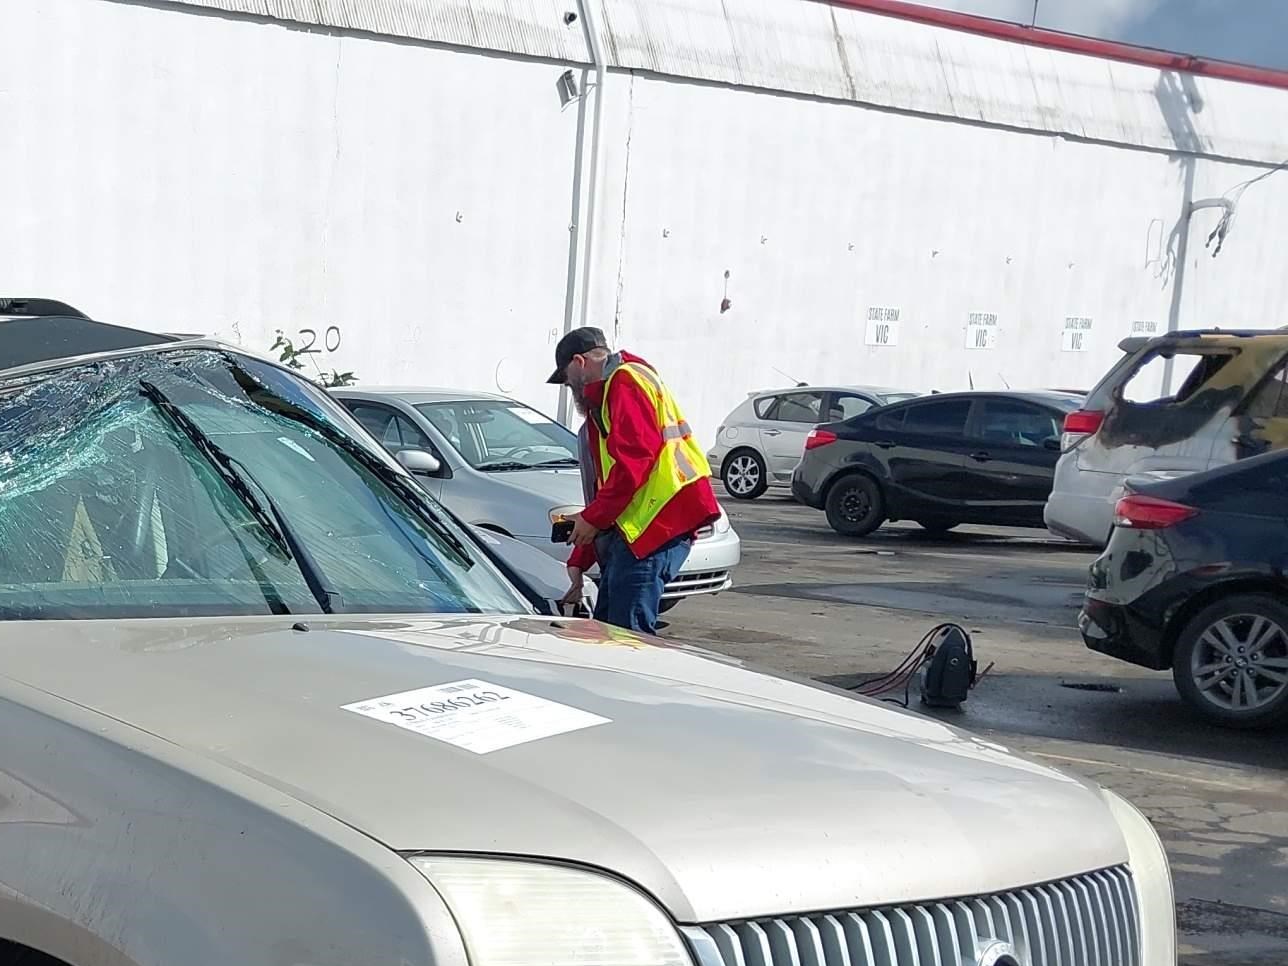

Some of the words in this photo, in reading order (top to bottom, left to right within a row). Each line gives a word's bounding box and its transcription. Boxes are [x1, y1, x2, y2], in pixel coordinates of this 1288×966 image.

[868, 307, 883, 321] STATE
[884, 308, 900, 321] FARM
[968, 313, 982, 326] STATE
[983, 313, 998, 326] FARM
[298, 326, 341, 353] 20
[875, 324, 889, 344] VIC
[975, 329, 988, 347] VIC
[1071, 332, 1083, 350] VIC
[389, 691, 510, 721] 37686262
